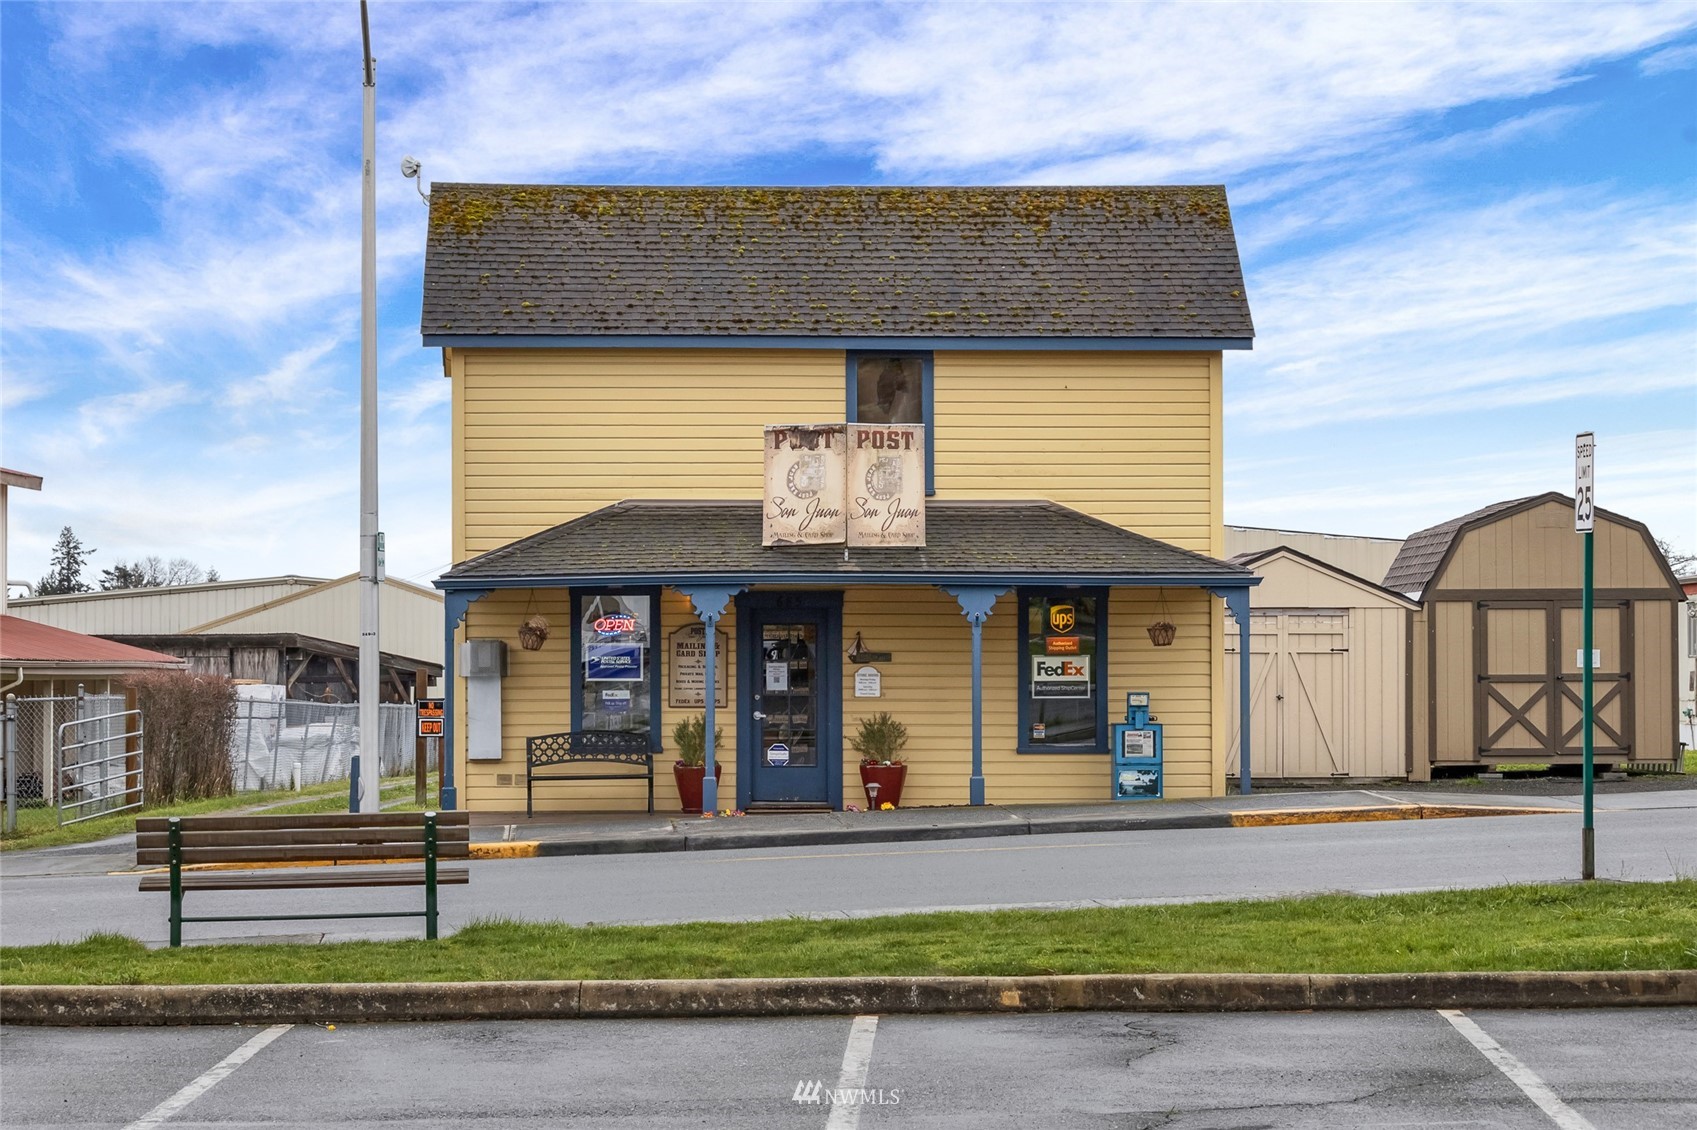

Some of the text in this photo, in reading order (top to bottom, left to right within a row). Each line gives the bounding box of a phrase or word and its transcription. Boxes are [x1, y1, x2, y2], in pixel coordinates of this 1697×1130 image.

[774, 430, 835, 449] PT
[857, 430, 914, 450] POST
[1577, 443, 1592, 458] SPEED
[1578, 465, 1591, 479] LIMIT
[1577, 486, 1591, 521] 25
[766, 497, 841, 531] San Juan
[850, 497, 919, 531] San Juan
[594, 618, 636, 631] OPEN
[1053, 614, 1073, 629] ups
[1037, 661, 1084, 676] FedEx
[422, 722, 441, 733] KEEP OUT
